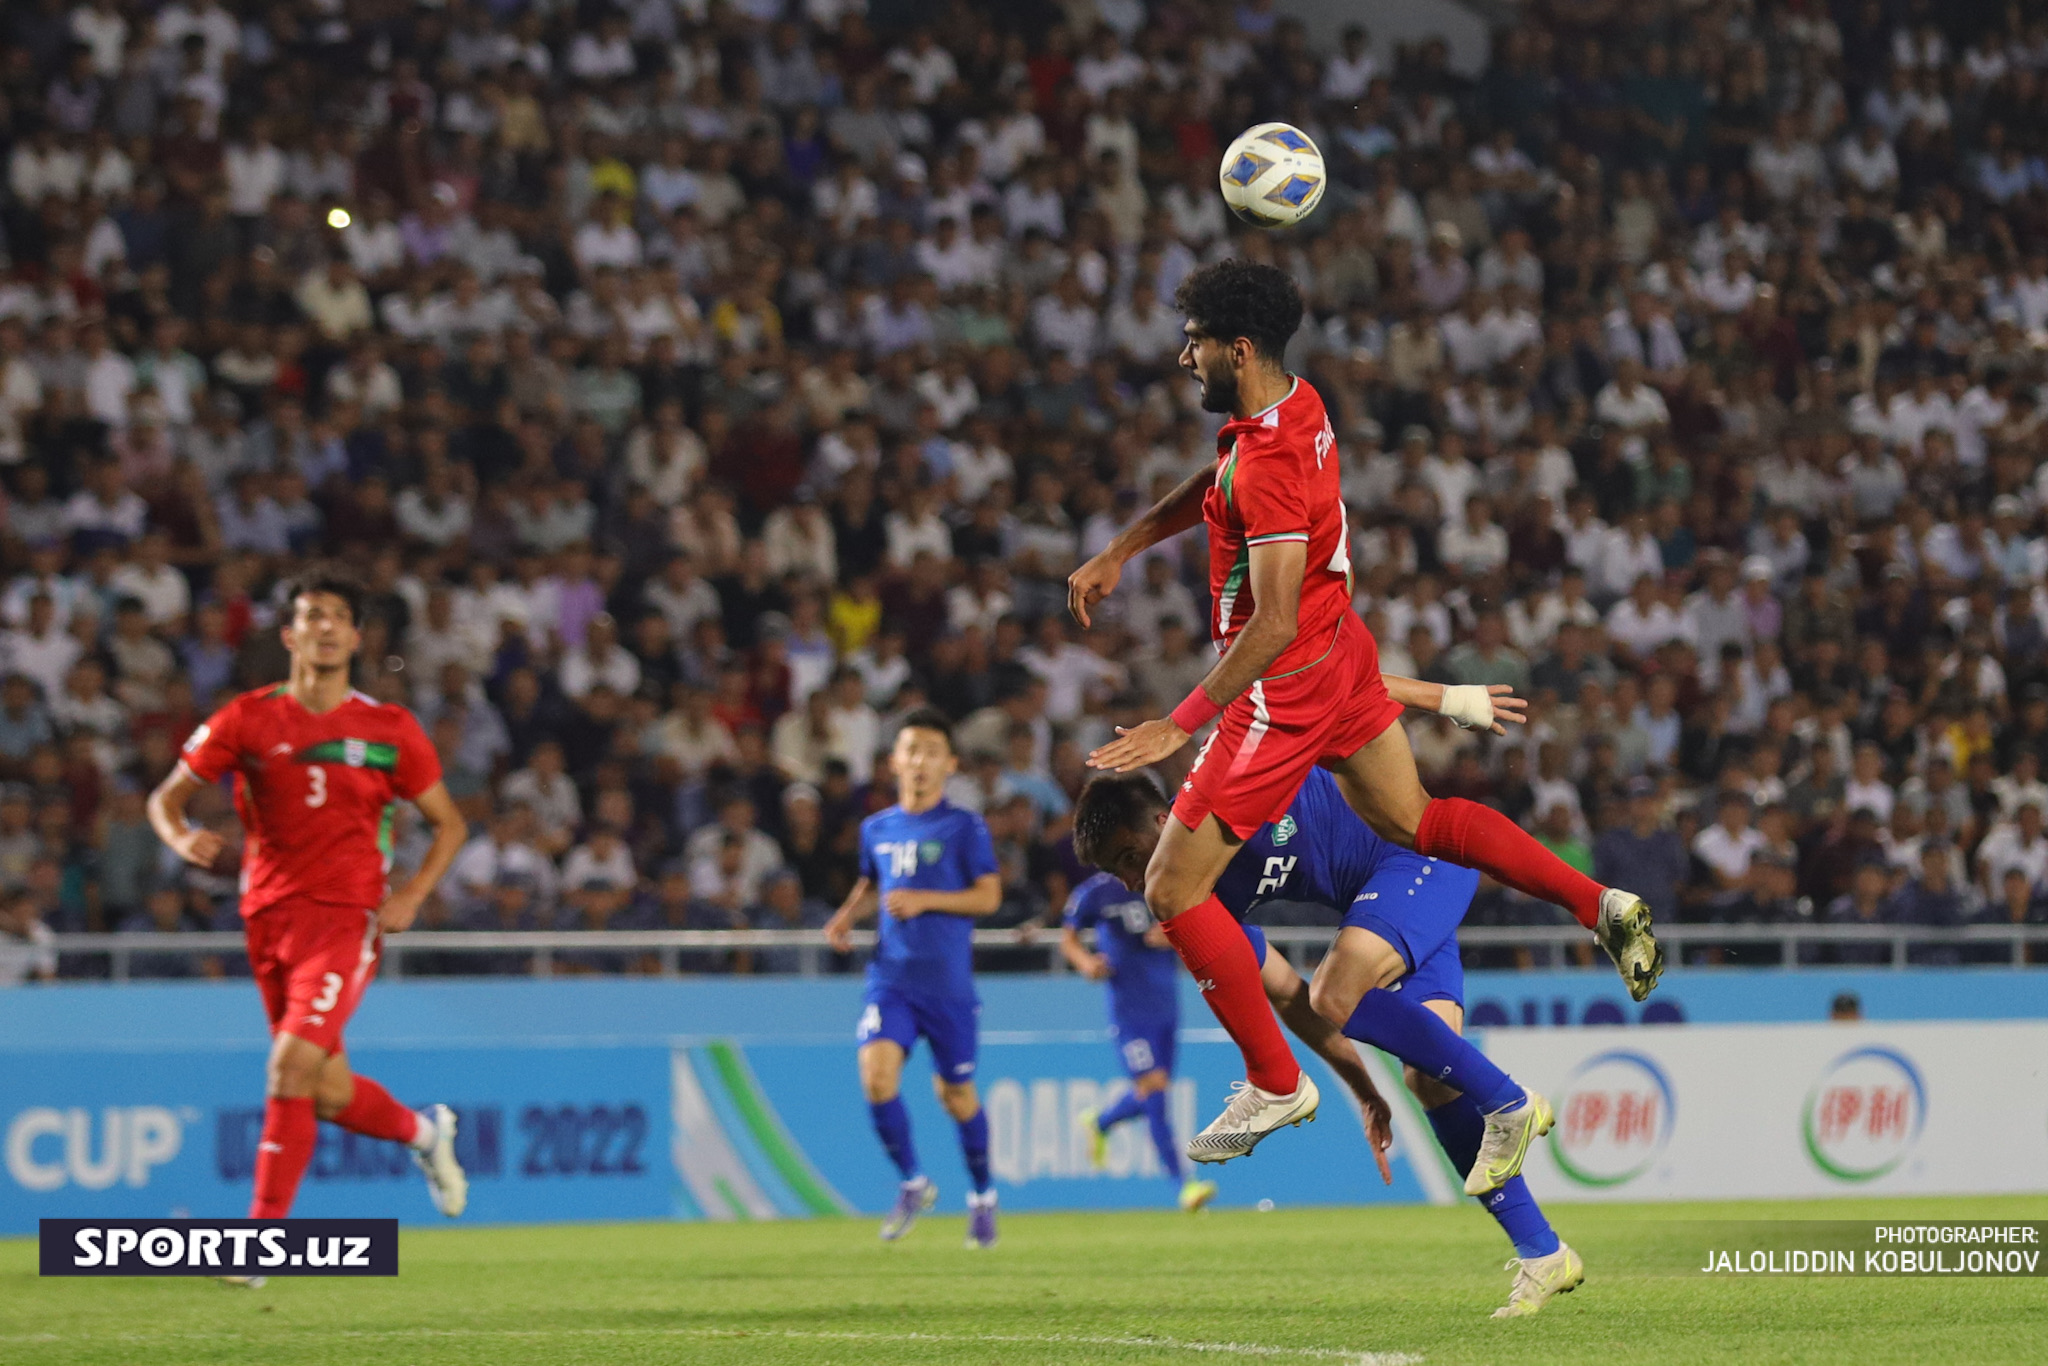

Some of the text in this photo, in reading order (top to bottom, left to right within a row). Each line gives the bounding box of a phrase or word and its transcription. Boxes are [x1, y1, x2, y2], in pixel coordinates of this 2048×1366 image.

[305, 765, 327, 808] 3
[890, 840, 919, 878] 14
[1255, 855, 1298, 895] 22
[311, 971, 343, 1012] 3
[6, 1106, 183, 1192] CUP
[519, 1103, 649, 1177] 2022
